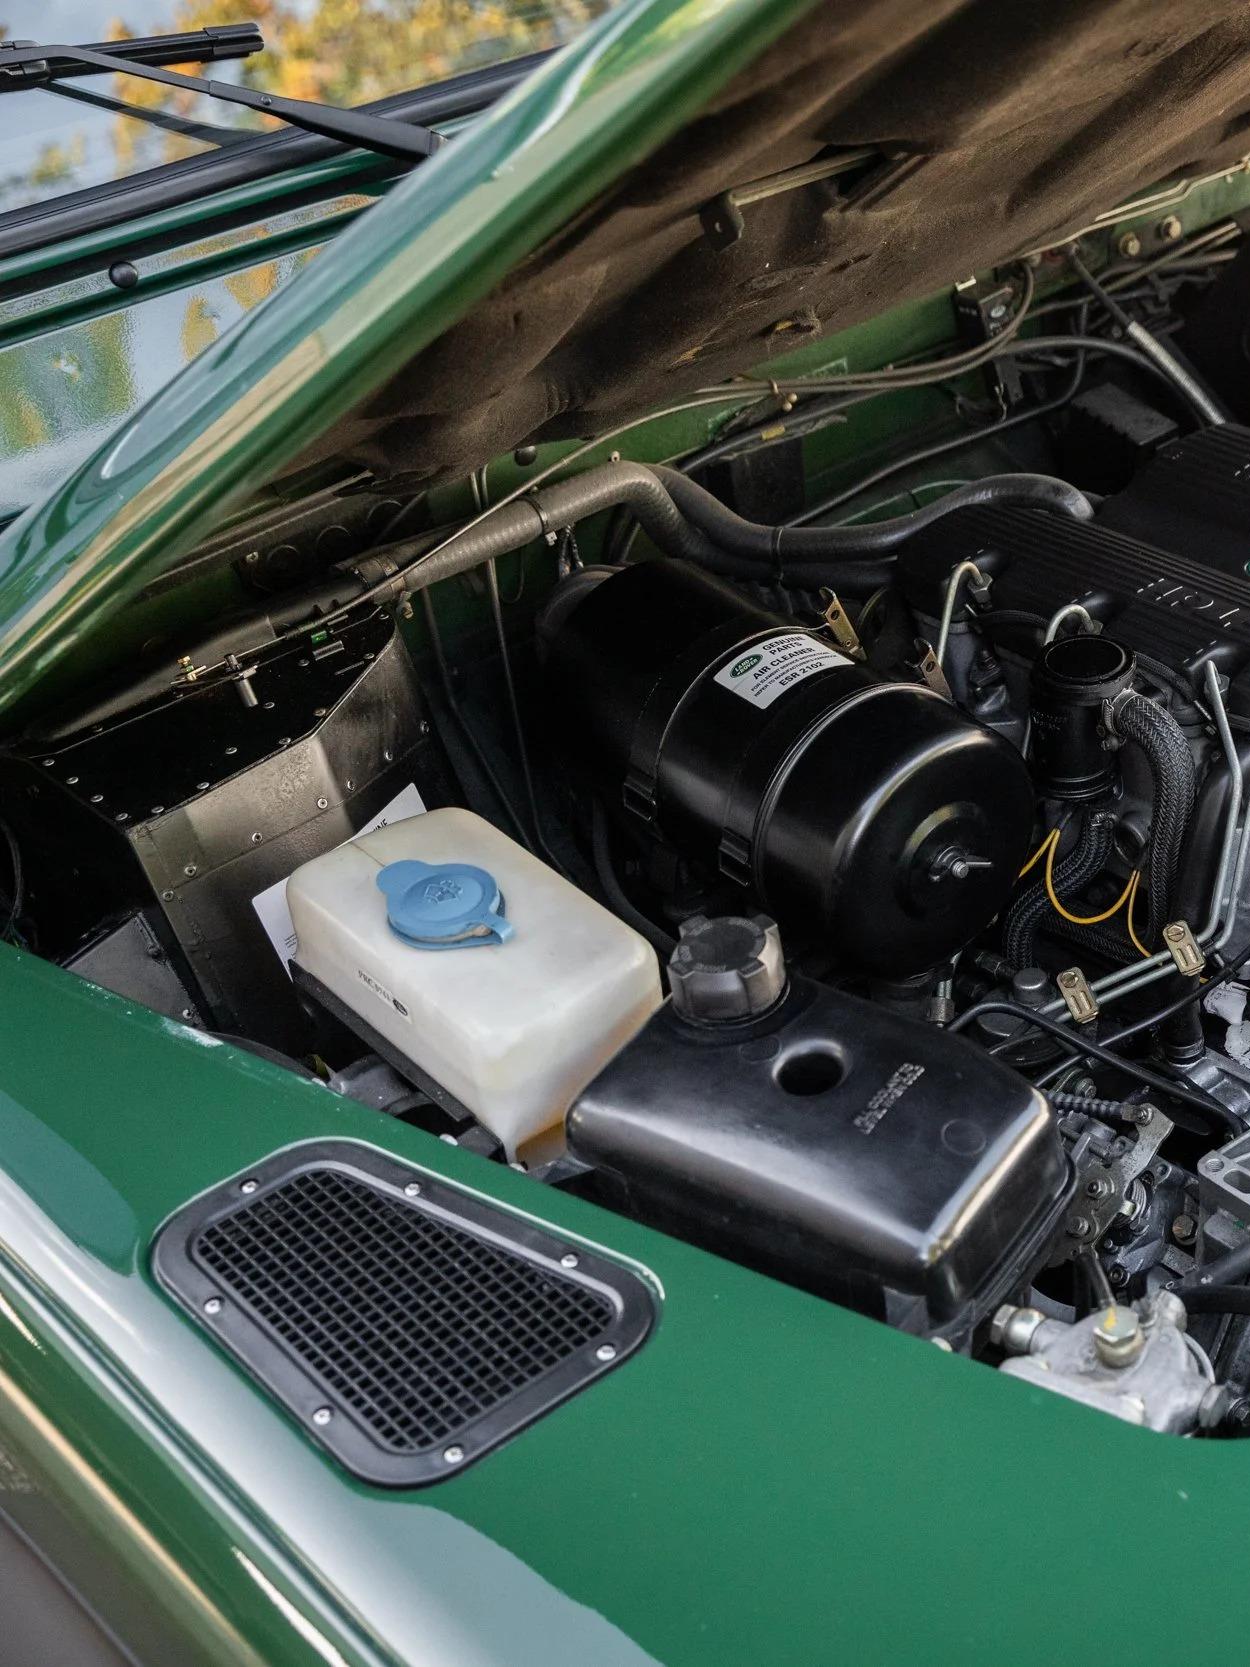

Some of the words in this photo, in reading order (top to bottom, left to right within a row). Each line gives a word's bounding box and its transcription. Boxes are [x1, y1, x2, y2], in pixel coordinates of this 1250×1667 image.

[762, 636, 806, 651] GENUINE
[769, 641, 802, 656] PARTS
[734, 657, 751, 672] LAND
[739, 658, 758, 674] ROVER
[752, 665, 771, 680] AIR
[770, 647, 816, 667] CLEANER
[779, 671, 800, 686] ESR
[800, 661, 824, 674] 2102
